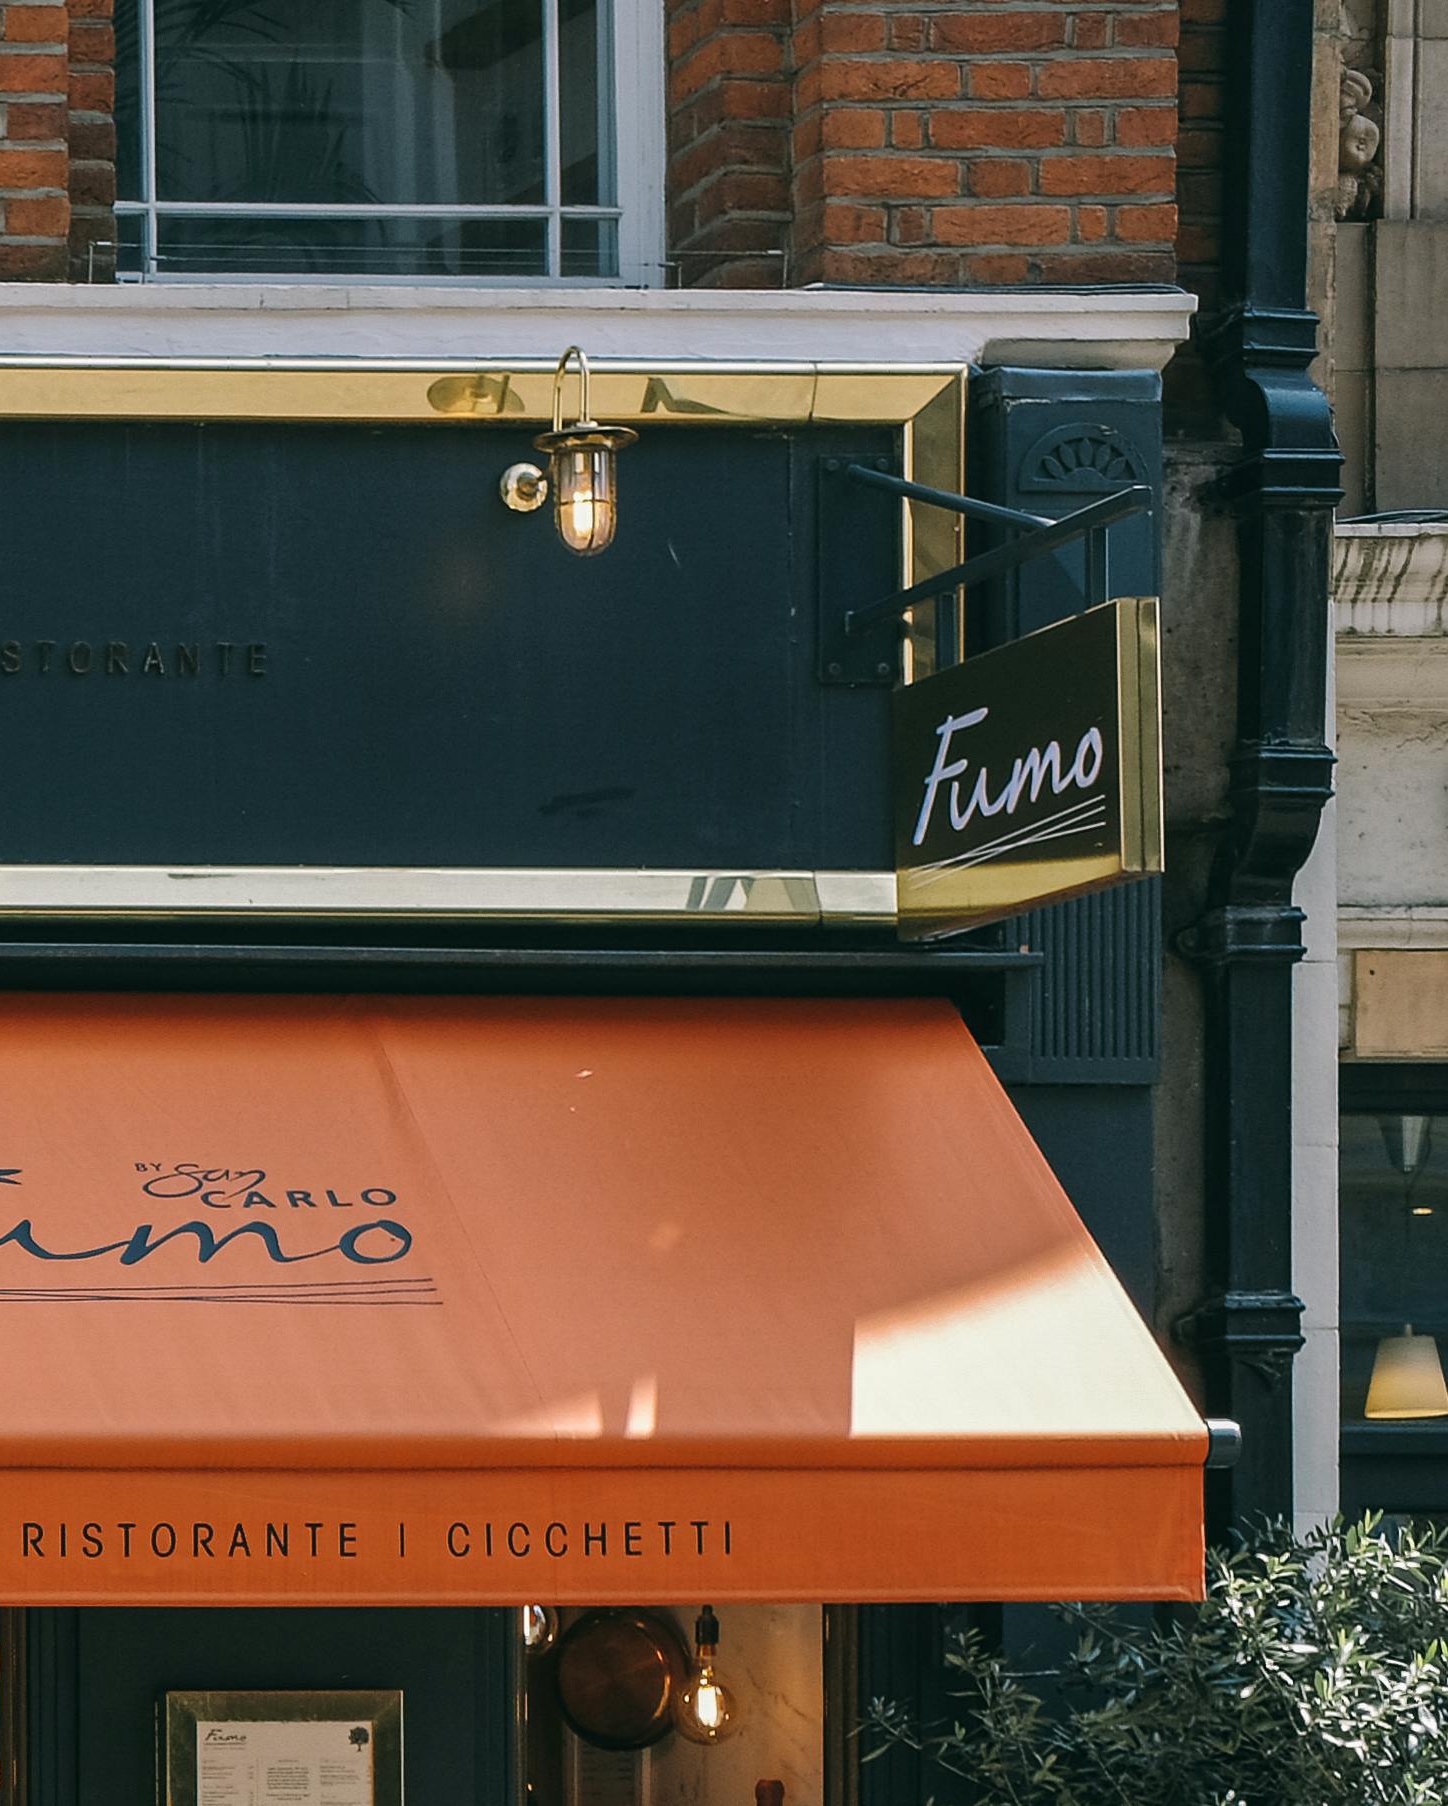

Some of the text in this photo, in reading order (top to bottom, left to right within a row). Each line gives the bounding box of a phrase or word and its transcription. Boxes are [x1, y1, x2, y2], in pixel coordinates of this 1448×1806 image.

[913, 707, 1104, 846] Fumo
[134, 1162, 267, 1200] BY San
[201, 1186, 398, 1209] CARLO
[21, 1521, 358, 1558] RISTORANTE
[446, 1521, 731, 1558] CICCHETTI
